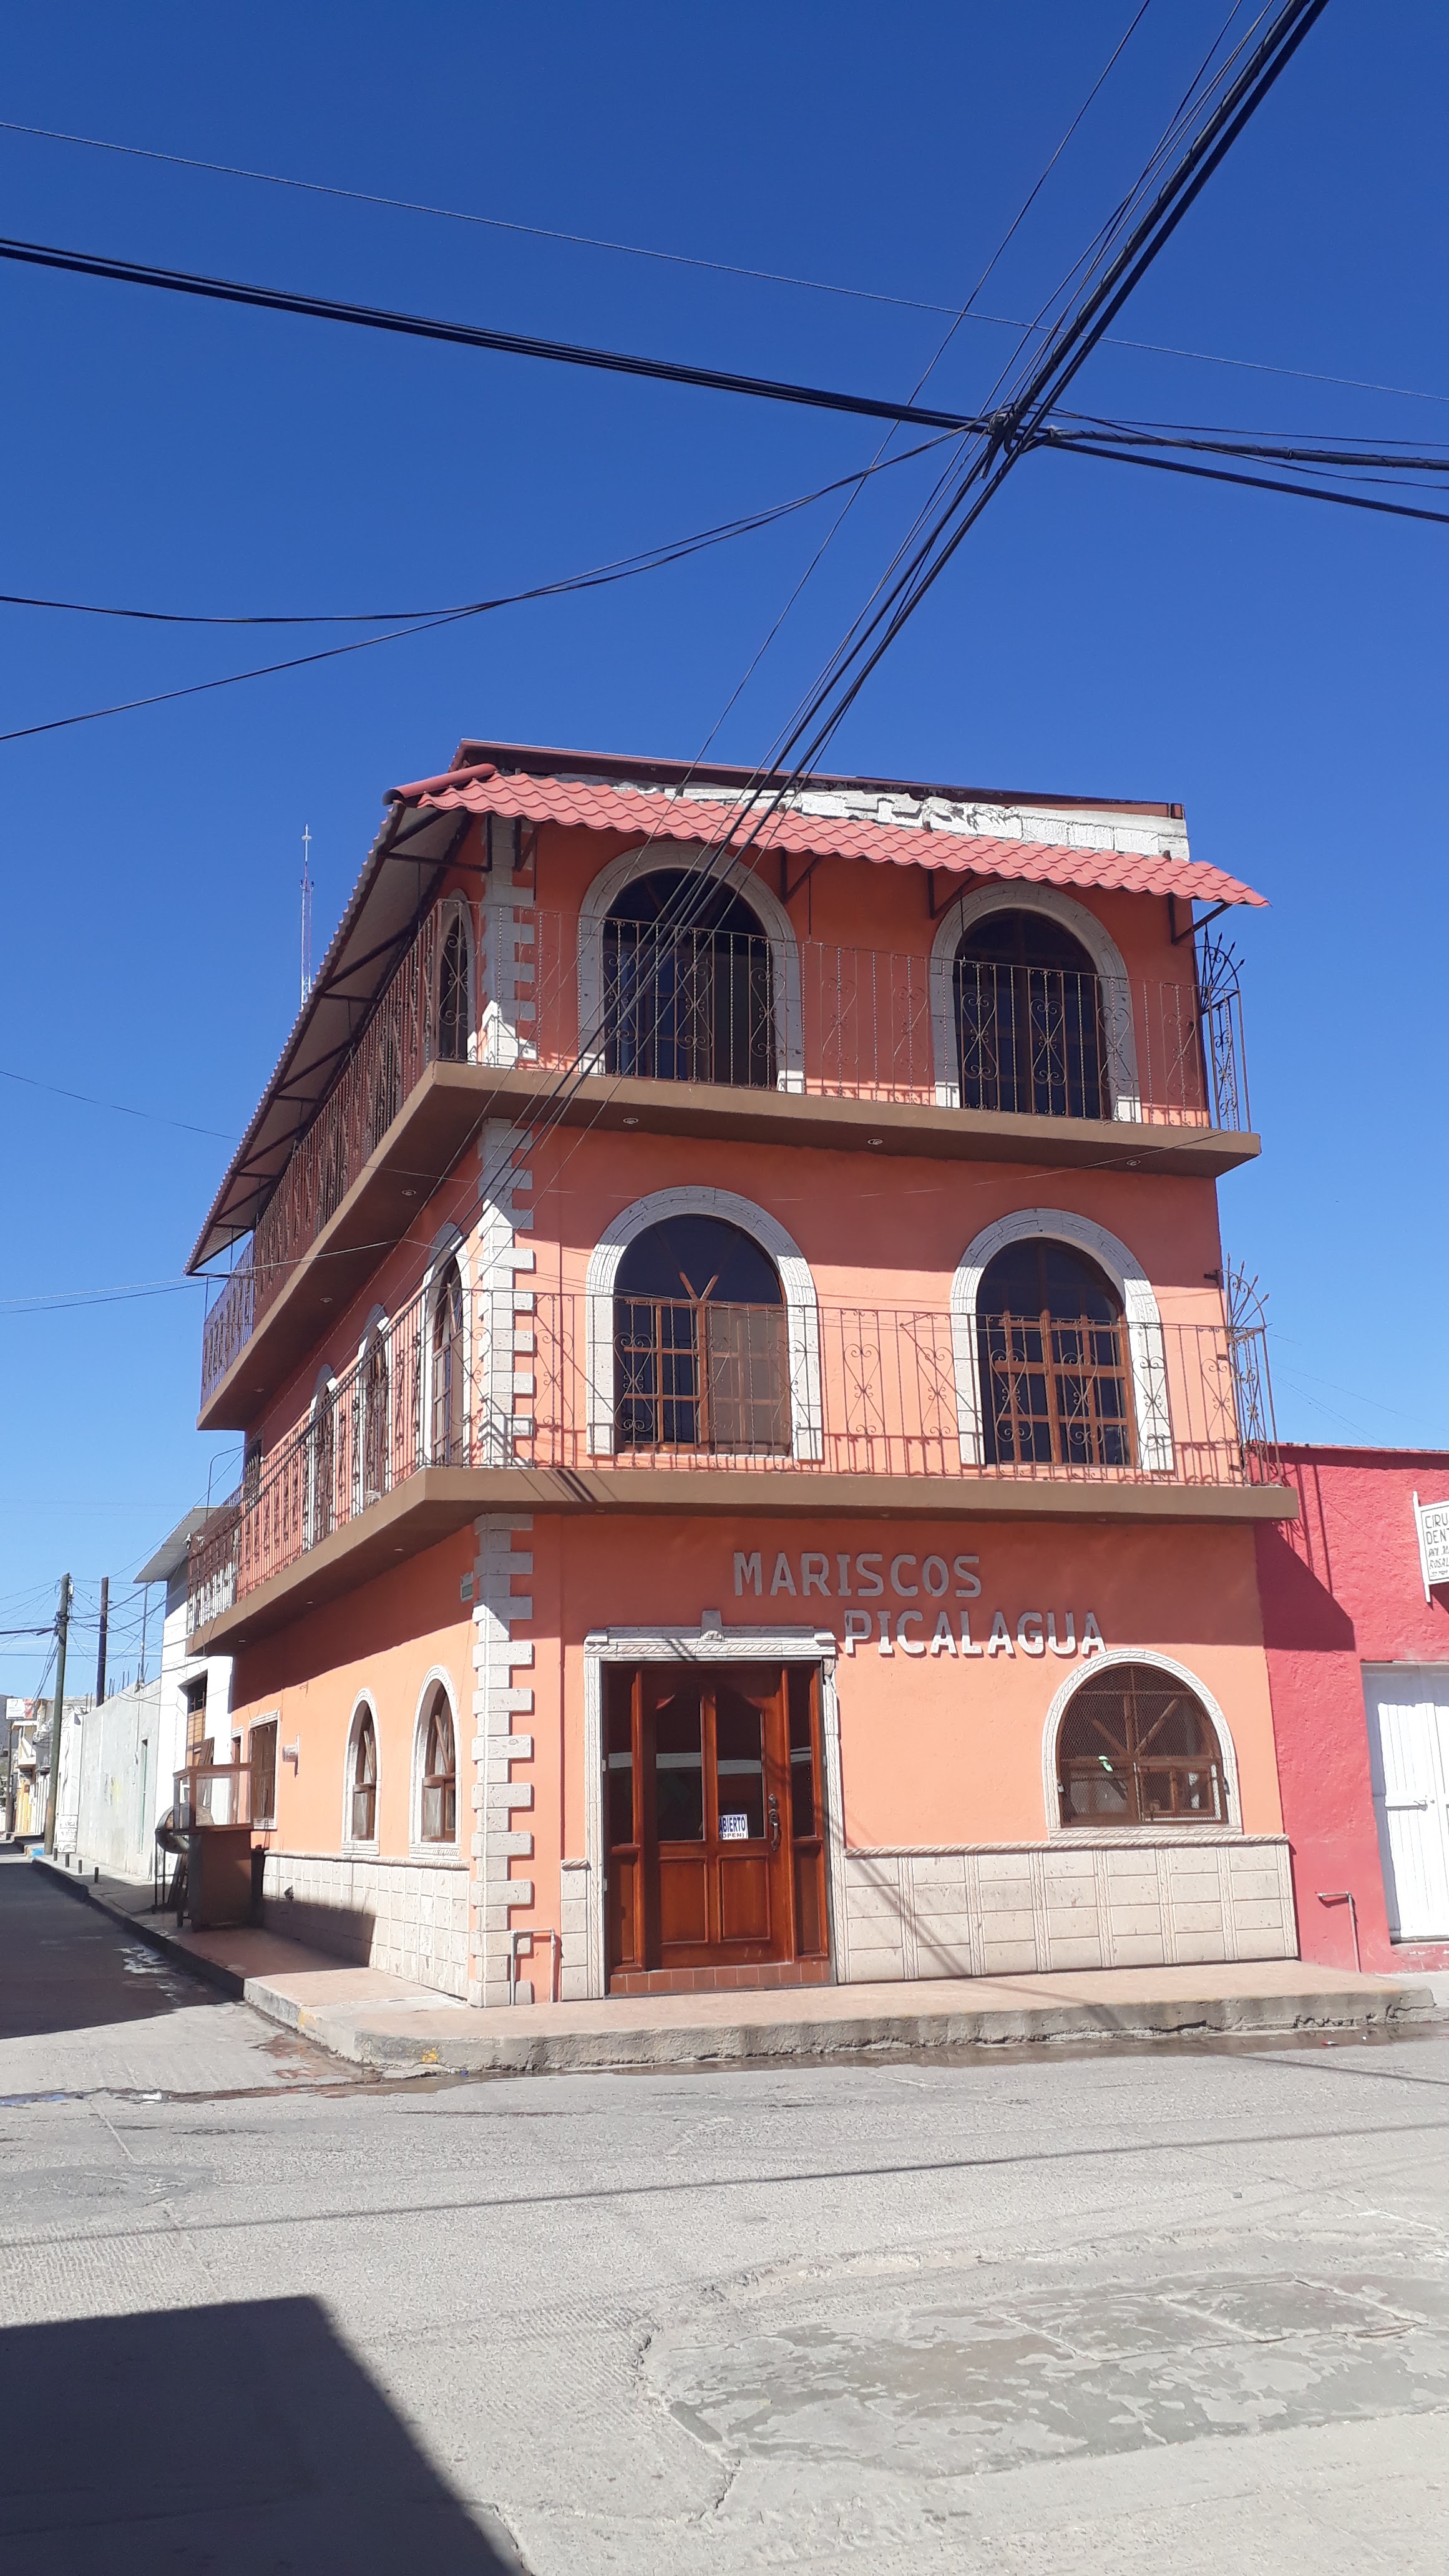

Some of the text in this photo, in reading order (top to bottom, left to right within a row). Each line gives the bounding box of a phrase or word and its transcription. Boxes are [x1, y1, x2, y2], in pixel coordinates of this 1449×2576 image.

[1425, 1513, 1449, 1529] CIRU
[734, 1552, 981, 1598] MARISCOS
[844, 1609, 1106, 1655] PICALAGUA
[719, 1816, 745, 1832] ABIERTO
